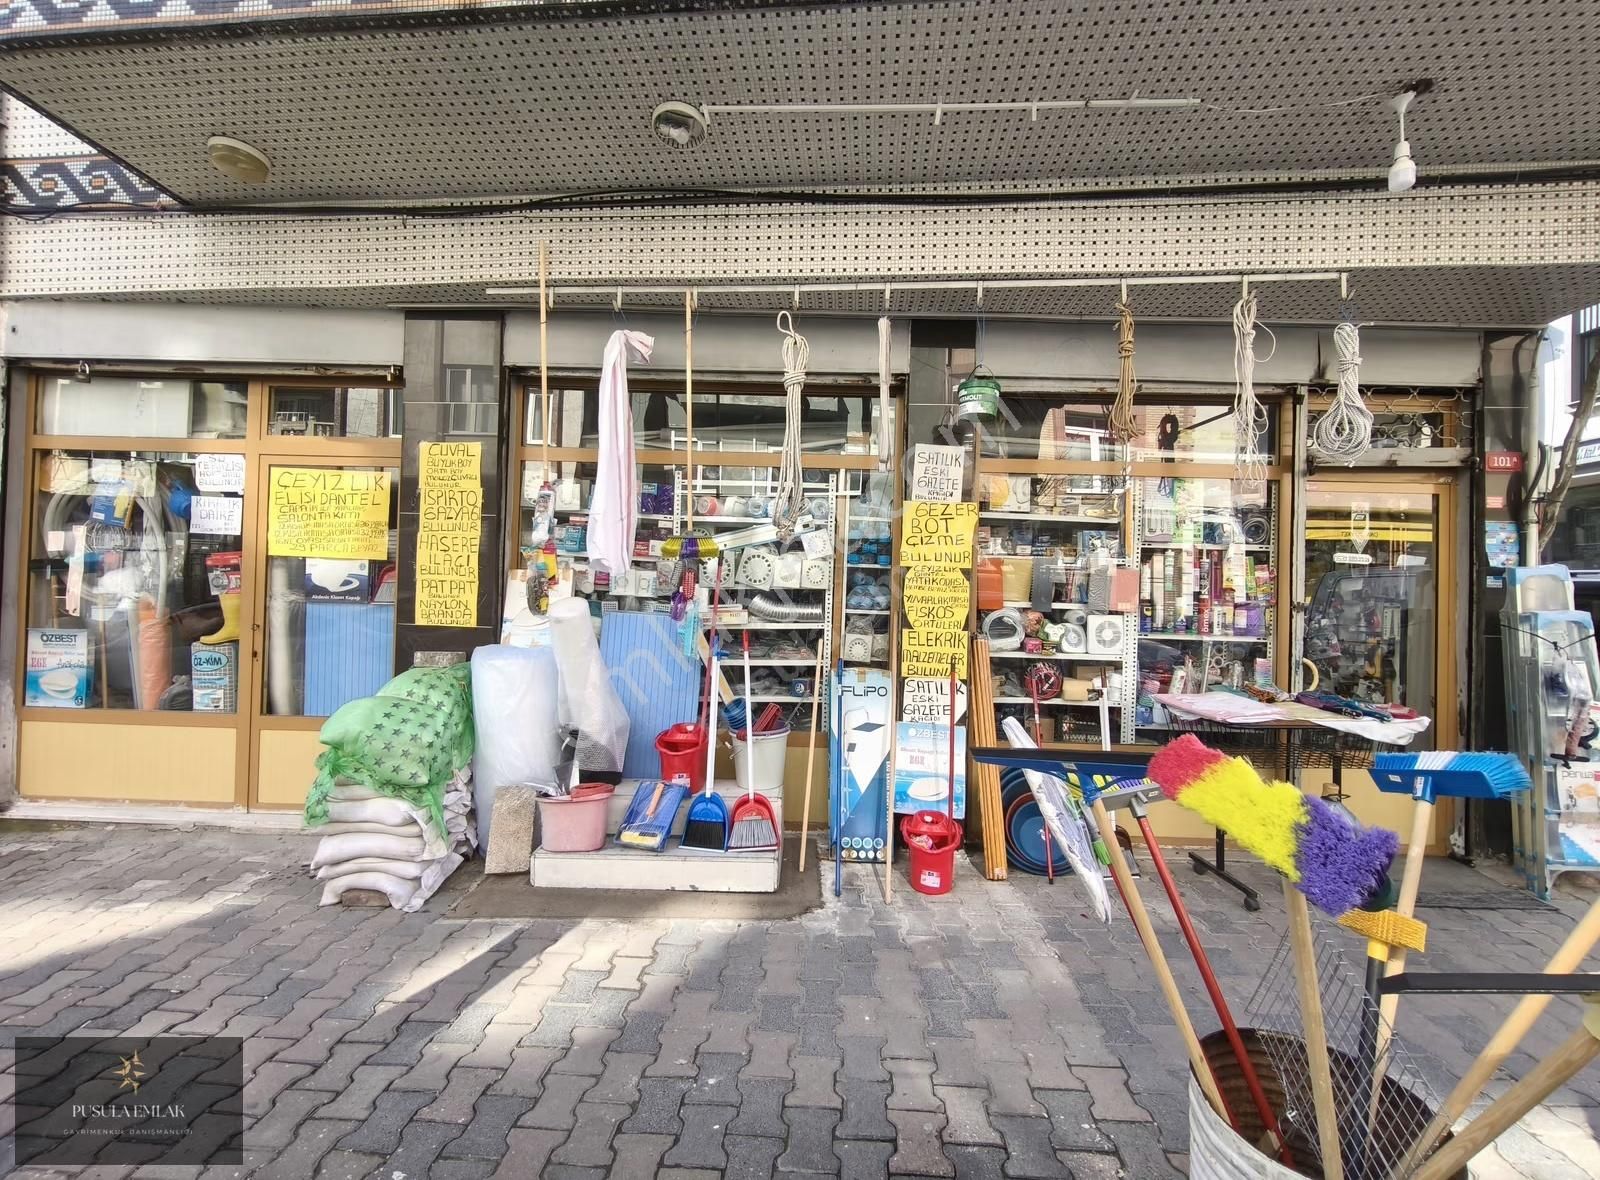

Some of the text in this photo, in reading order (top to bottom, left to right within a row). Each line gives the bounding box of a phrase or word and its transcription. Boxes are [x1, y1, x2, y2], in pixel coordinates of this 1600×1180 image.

[917, 451, 961, 468] SATILIK
[1493, 456, 1511, 467] 101
[917, 475, 960, 491] GAZETE
[320, 493, 382, 506] DANTEL
[424, 489, 478, 507] ISPIRTO
[915, 502, 978, 517] GEZER
[423, 521, 479, 533] BULUNUR
[911, 516, 955, 534] BOT
[900, 550, 971, 565] BULUNUR
[420, 564, 476, 579] BULUNUR
[421, 579, 476, 595] PAT PAT
[419, 598, 469, 610] NAYLON
[421, 607, 472, 619] BRANDA
[905, 679, 965, 696] SATILK
[903, 703, 951, 716] GAZETE
